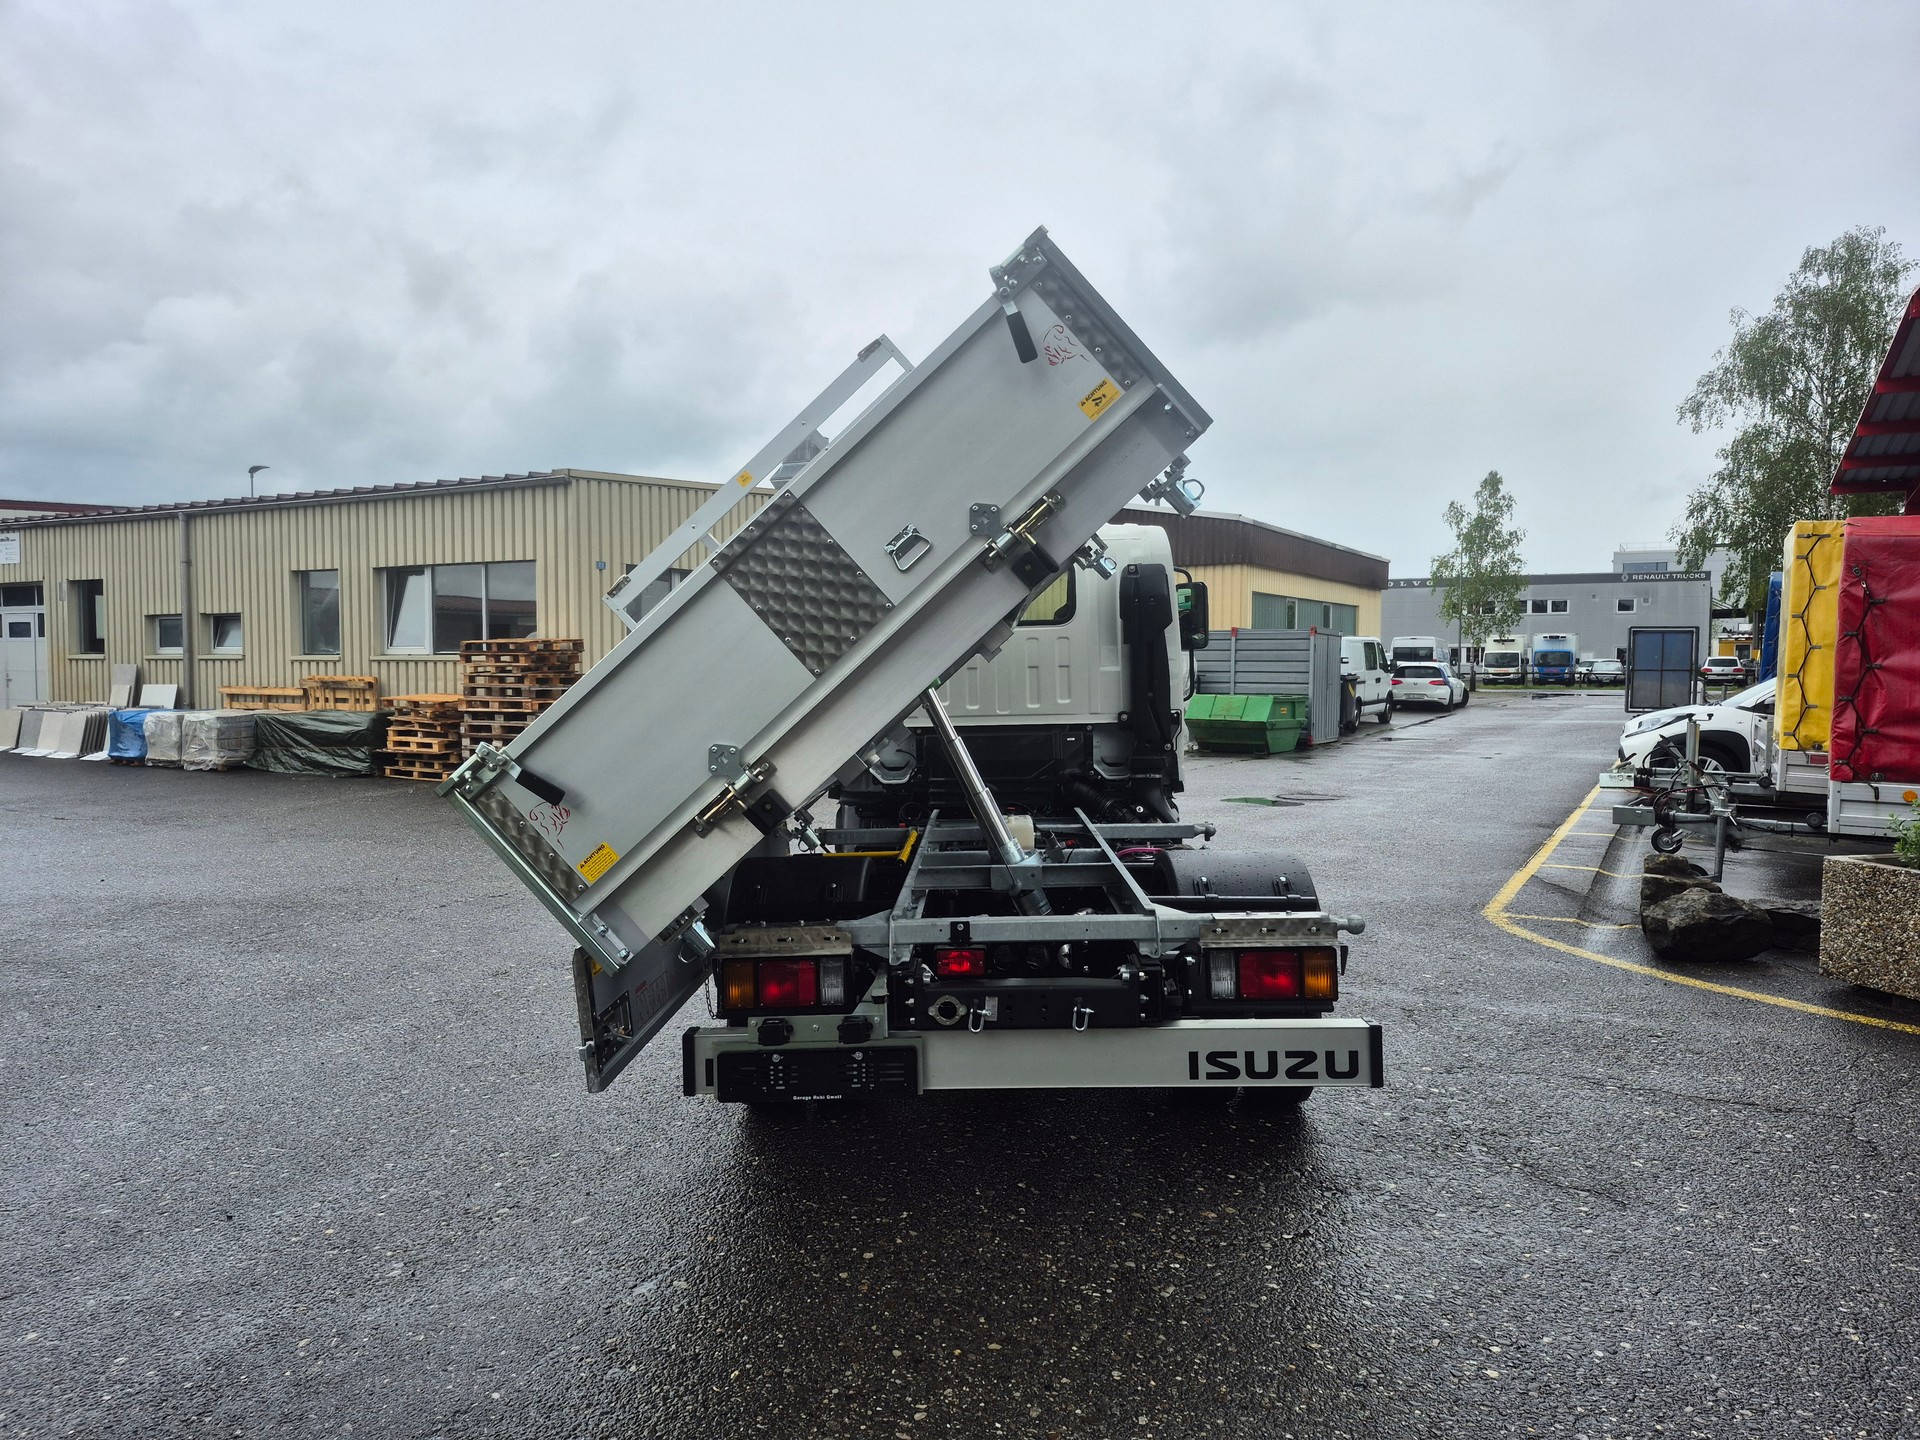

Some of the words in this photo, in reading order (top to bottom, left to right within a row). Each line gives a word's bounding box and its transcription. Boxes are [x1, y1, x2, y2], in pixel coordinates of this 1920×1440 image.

[1085, 380, 1107, 402] ACHTUNG
[1632, 573, 1671, 581] RENAULT
[1672, 572, 1706, 580] TRUCKS
[584, 844, 605, 865] ACHTUNG
[1188, 1050, 1360, 1080] ISUZU
